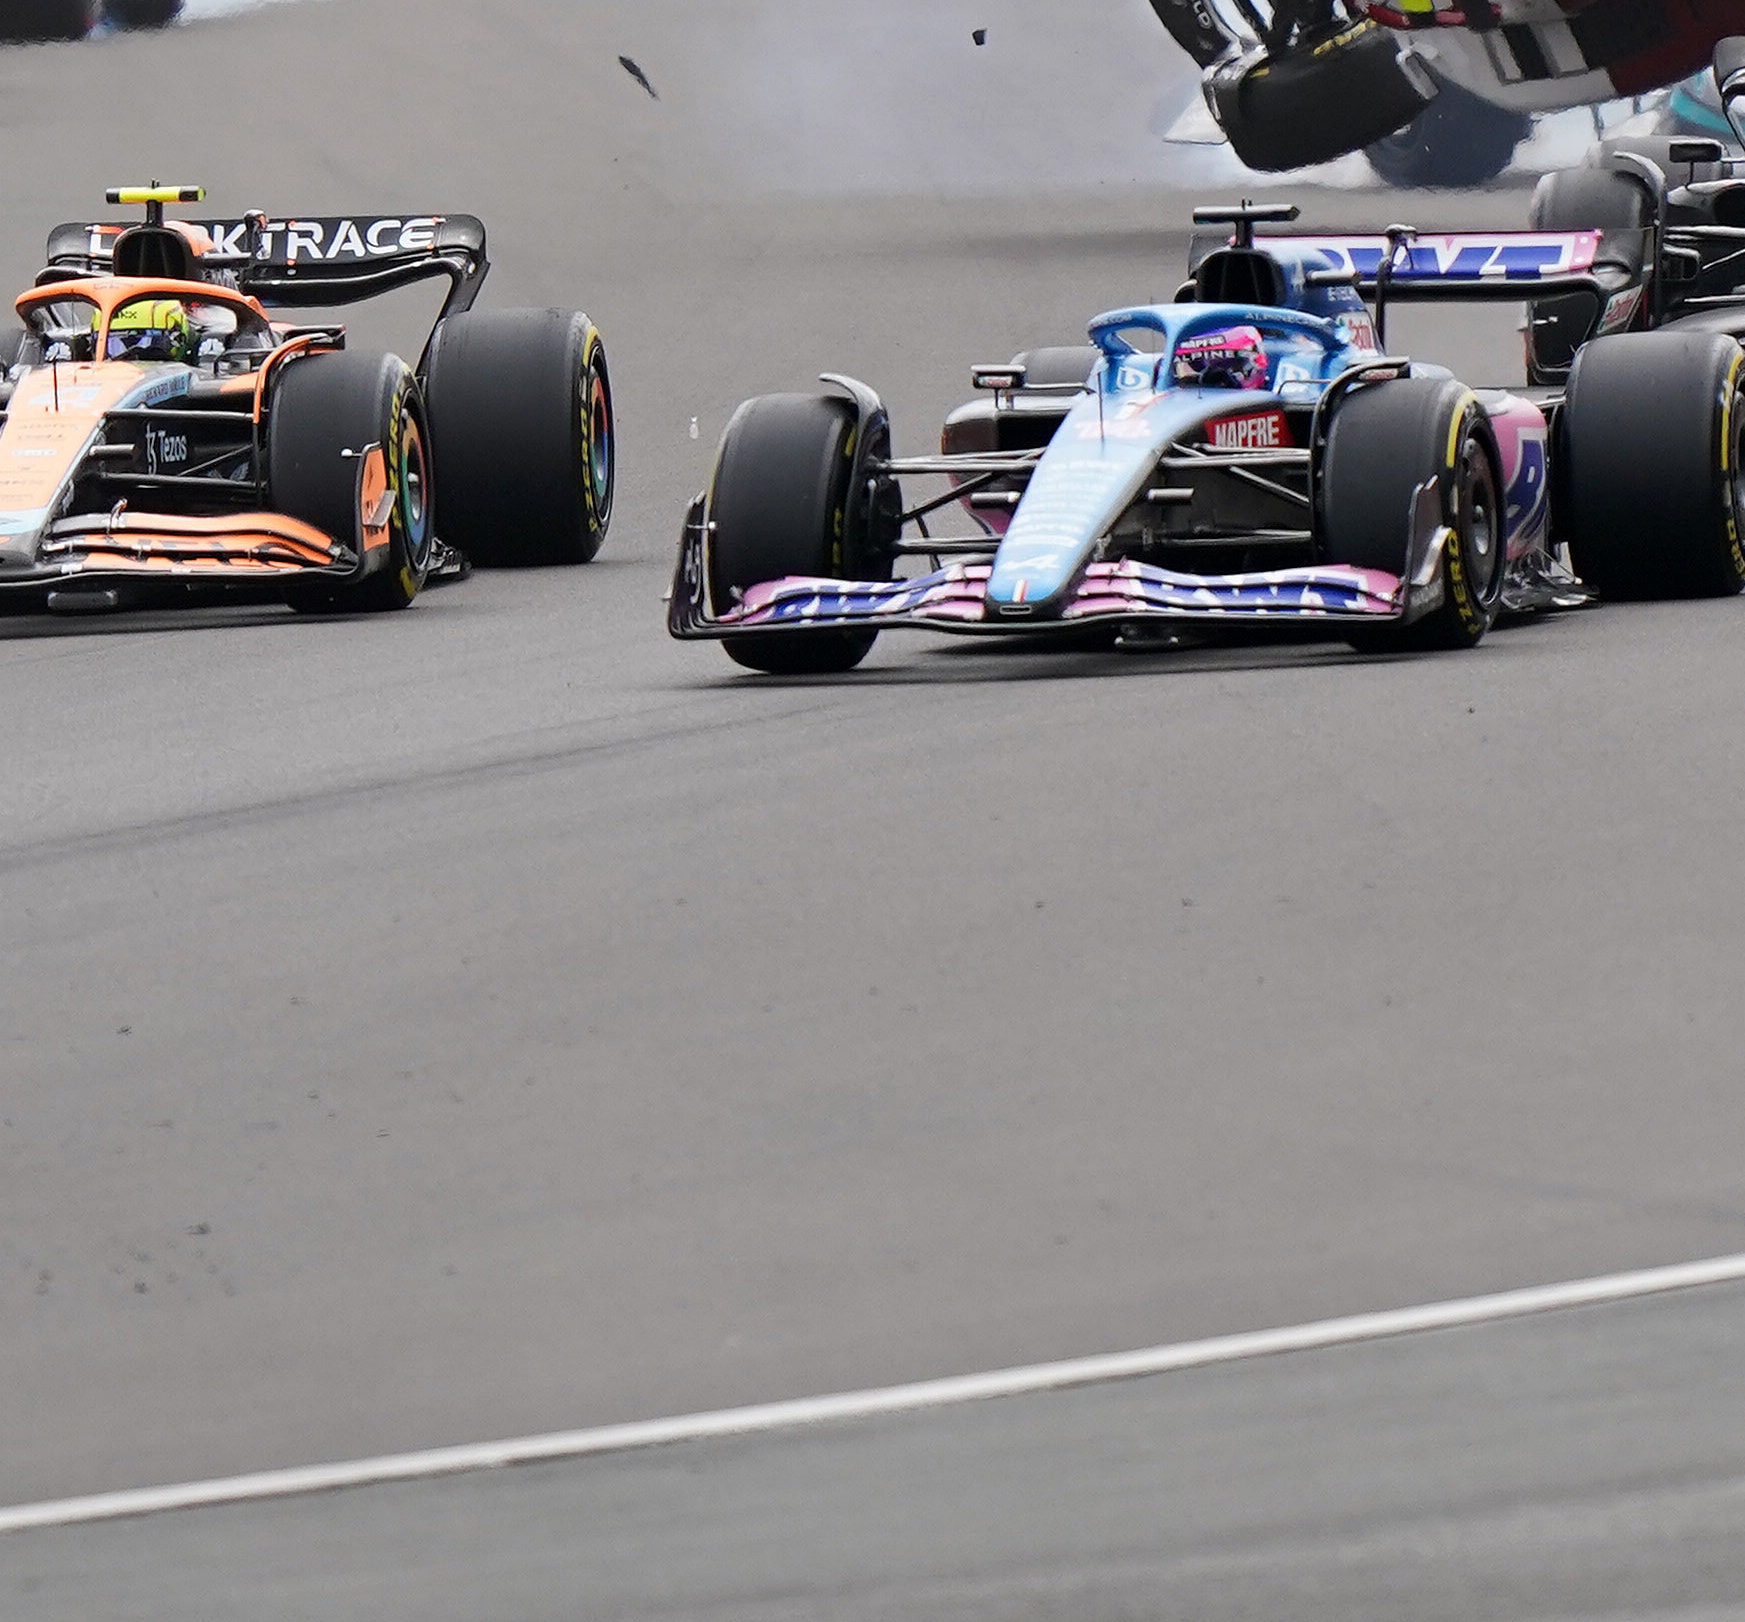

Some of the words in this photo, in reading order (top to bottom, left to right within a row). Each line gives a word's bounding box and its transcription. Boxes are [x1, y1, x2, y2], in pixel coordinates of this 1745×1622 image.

[1173, 349, 1236, 363] ALPINE
[157, 430, 188, 464] Tezos
[1214, 415, 1280, 448] MAPFRE
